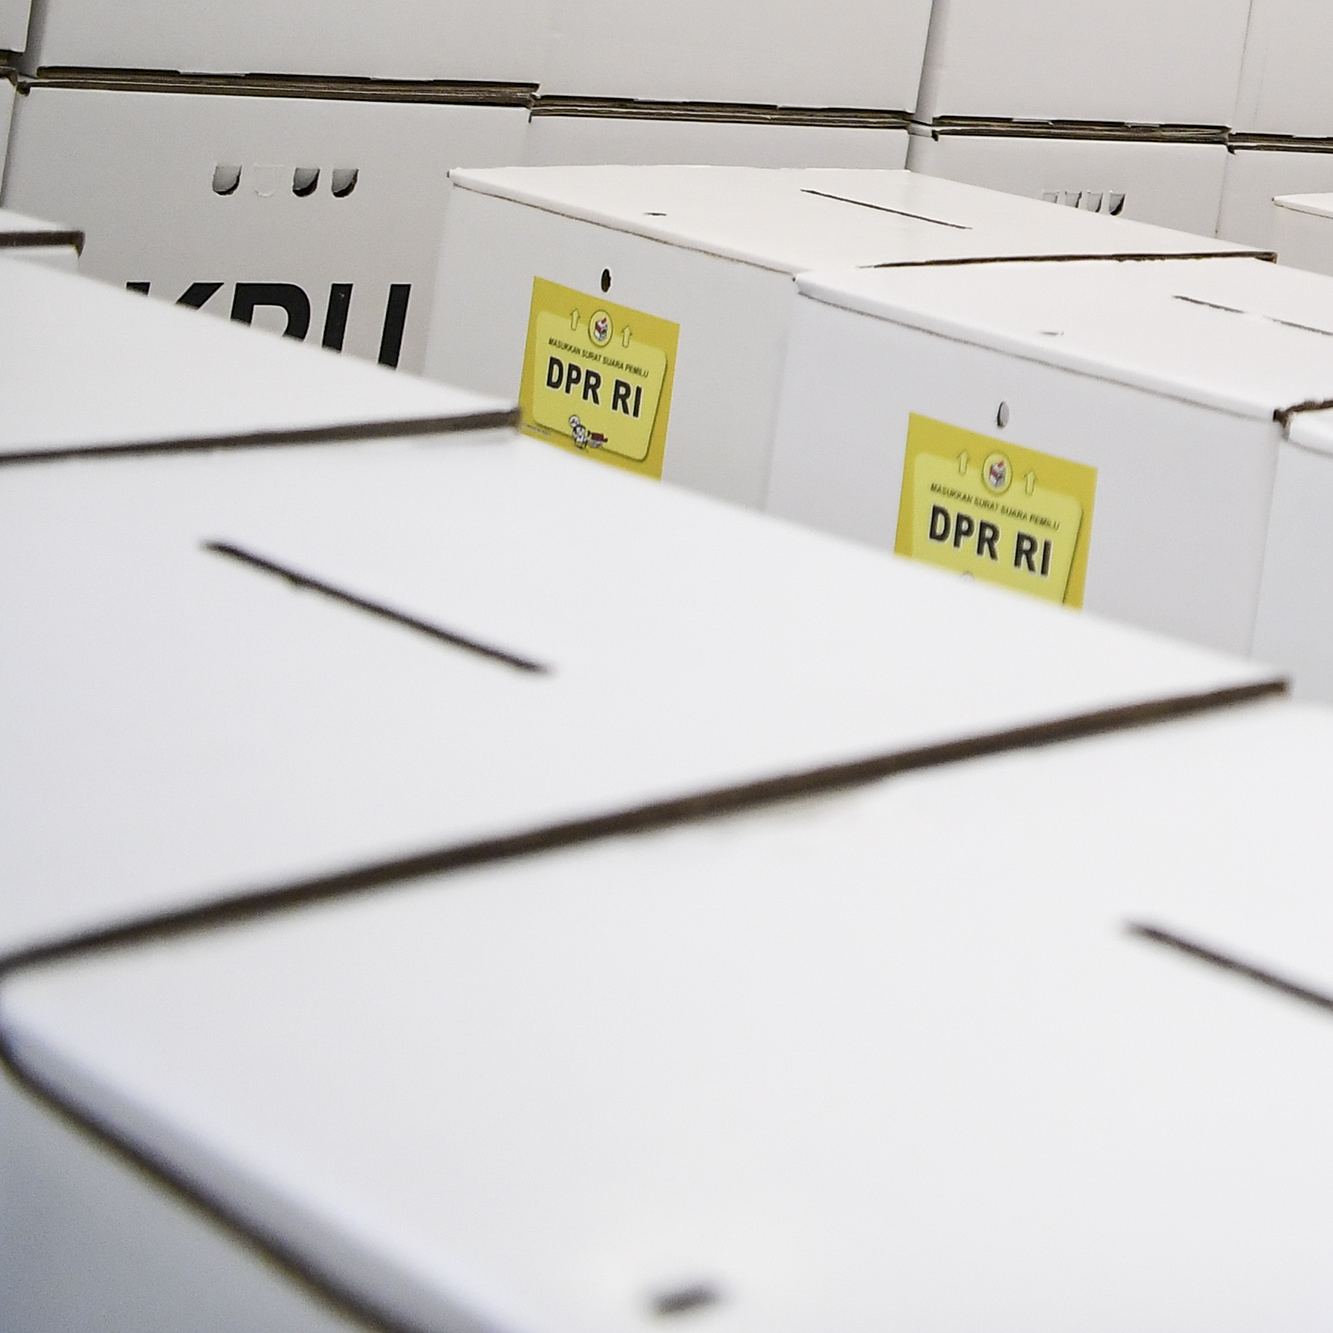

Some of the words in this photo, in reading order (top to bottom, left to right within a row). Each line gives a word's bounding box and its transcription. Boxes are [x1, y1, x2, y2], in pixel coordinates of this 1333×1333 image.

[548, 337, 581, 356] MASUKKAN
[582, 349, 602, 362] SURAT
[602, 356, 625, 369] SUARA
[625, 363, 650, 379] PEMILU
[546, 355, 602, 406] DPR
[612, 378, 643, 419] RI
[928, 503, 1001, 562] DPR
[1013, 530, 1052, 577] RI
[974, 496, 999, 513] SURAT
[1000, 505, 1028, 520] SUARA
[1029, 513, 1061, 531] PEMILU
